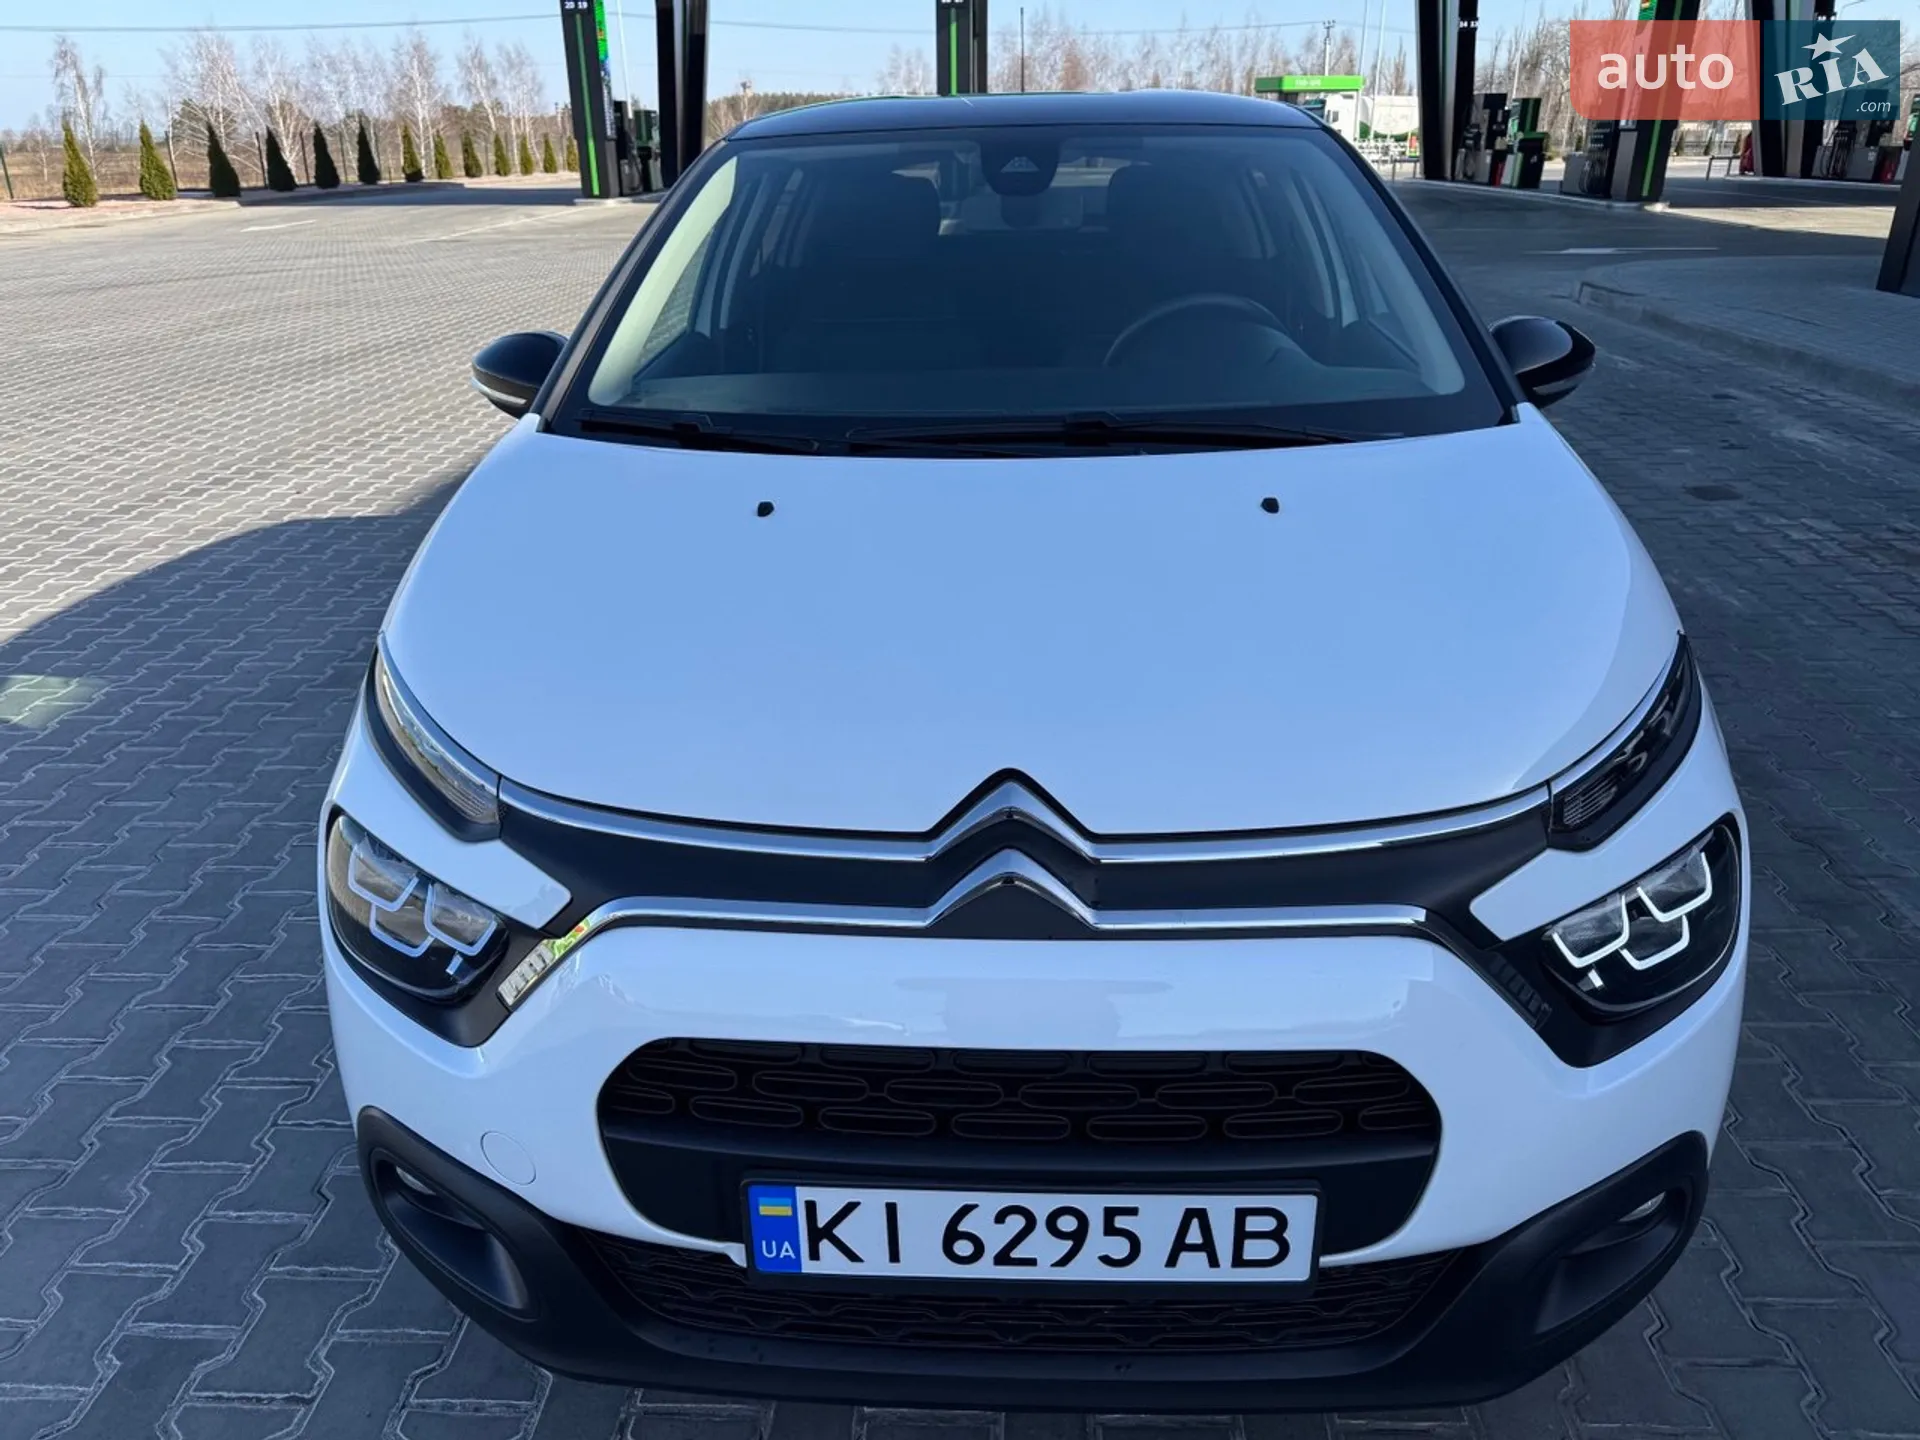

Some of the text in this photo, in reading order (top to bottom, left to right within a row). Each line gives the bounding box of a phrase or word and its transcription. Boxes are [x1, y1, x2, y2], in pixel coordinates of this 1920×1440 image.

[761, 1238, 796, 1260] UA
[803, 1199, 1291, 1270] KI 6295 AB
